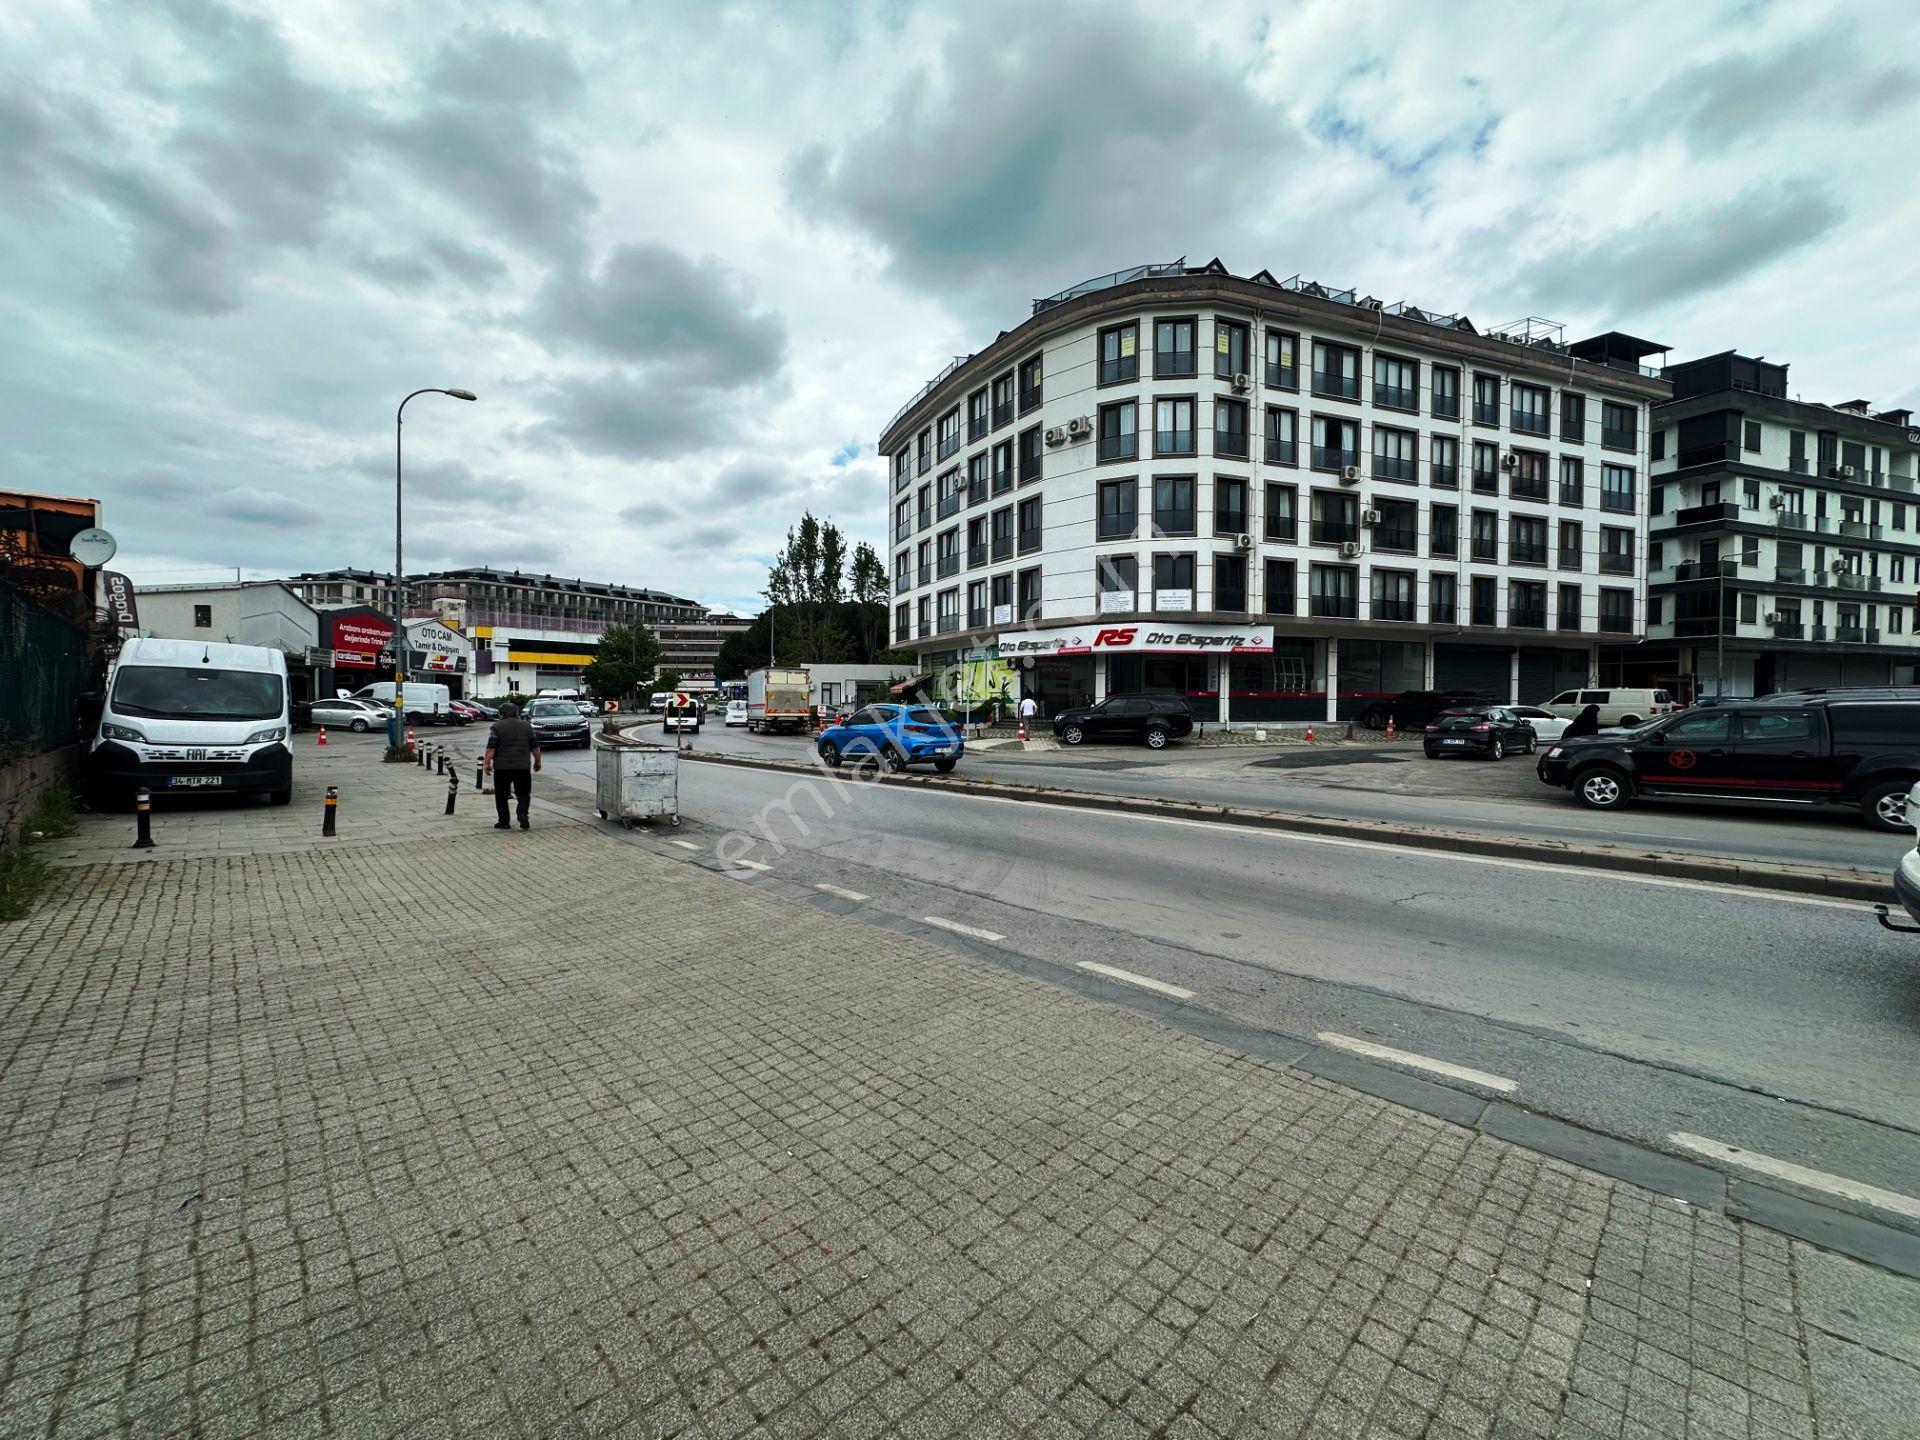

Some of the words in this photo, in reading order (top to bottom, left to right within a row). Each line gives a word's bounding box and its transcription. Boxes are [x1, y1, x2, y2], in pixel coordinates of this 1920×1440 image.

[421, 627, 437, 639] OTO
[437, 630, 452, 642] CAM
[1093, 628, 1138, 647] RS
[1145, 632, 1174, 645] Oto
[1175, 633, 1246, 649] Ekspertiz
[414, 640, 431, 650] Tamir
[186, 748, 208, 760] FIAT
[173, 777, 183, 785] 34
